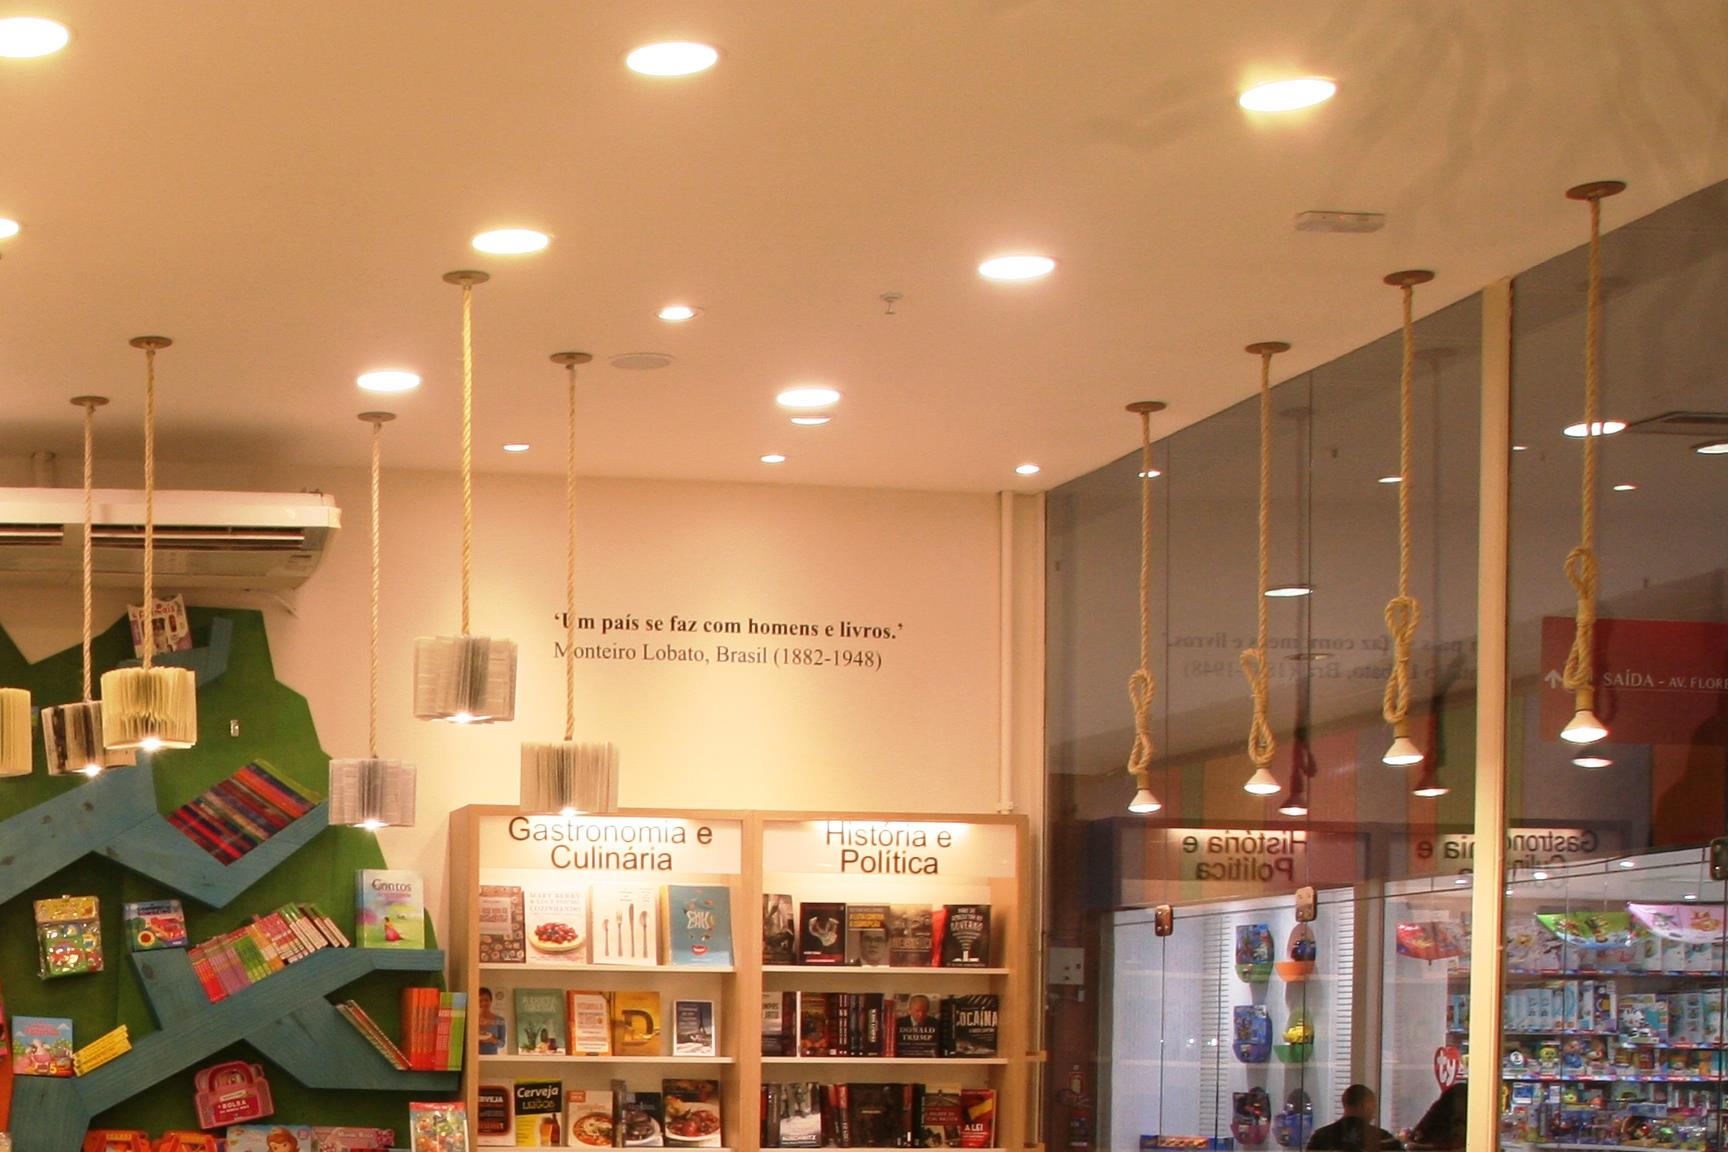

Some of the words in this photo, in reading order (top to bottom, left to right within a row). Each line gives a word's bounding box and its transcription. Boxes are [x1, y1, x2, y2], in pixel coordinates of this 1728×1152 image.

[602, 613, 640, 634] país
[645, 617, 664, 631] se
[670, 615, 697, 632] faz
[703, 619, 741, 634] com
[748, 618, 819, 637] homens
[825, 625, 834, 637] e
[554, 642, 636, 661] Monteiro
[642, 643, 710, 665] Lobato,
[716, 645, 768, 664] Brasil
[773, 648, 883, 671] (1882-1948)
[1603, 669, 1654, 687] SAÍDA
[1669, 676, 1688, 688] AV.
[508, 815, 688, 844] Gastronomia
[696, 825, 714, 845] e
[826, 820, 931, 848] História
[937, 829, 953, 848] e
[550, 845, 673, 871] Culinária
[840, 849, 940, 875] Política
[517, 1085, 559, 1099] Cerveja
